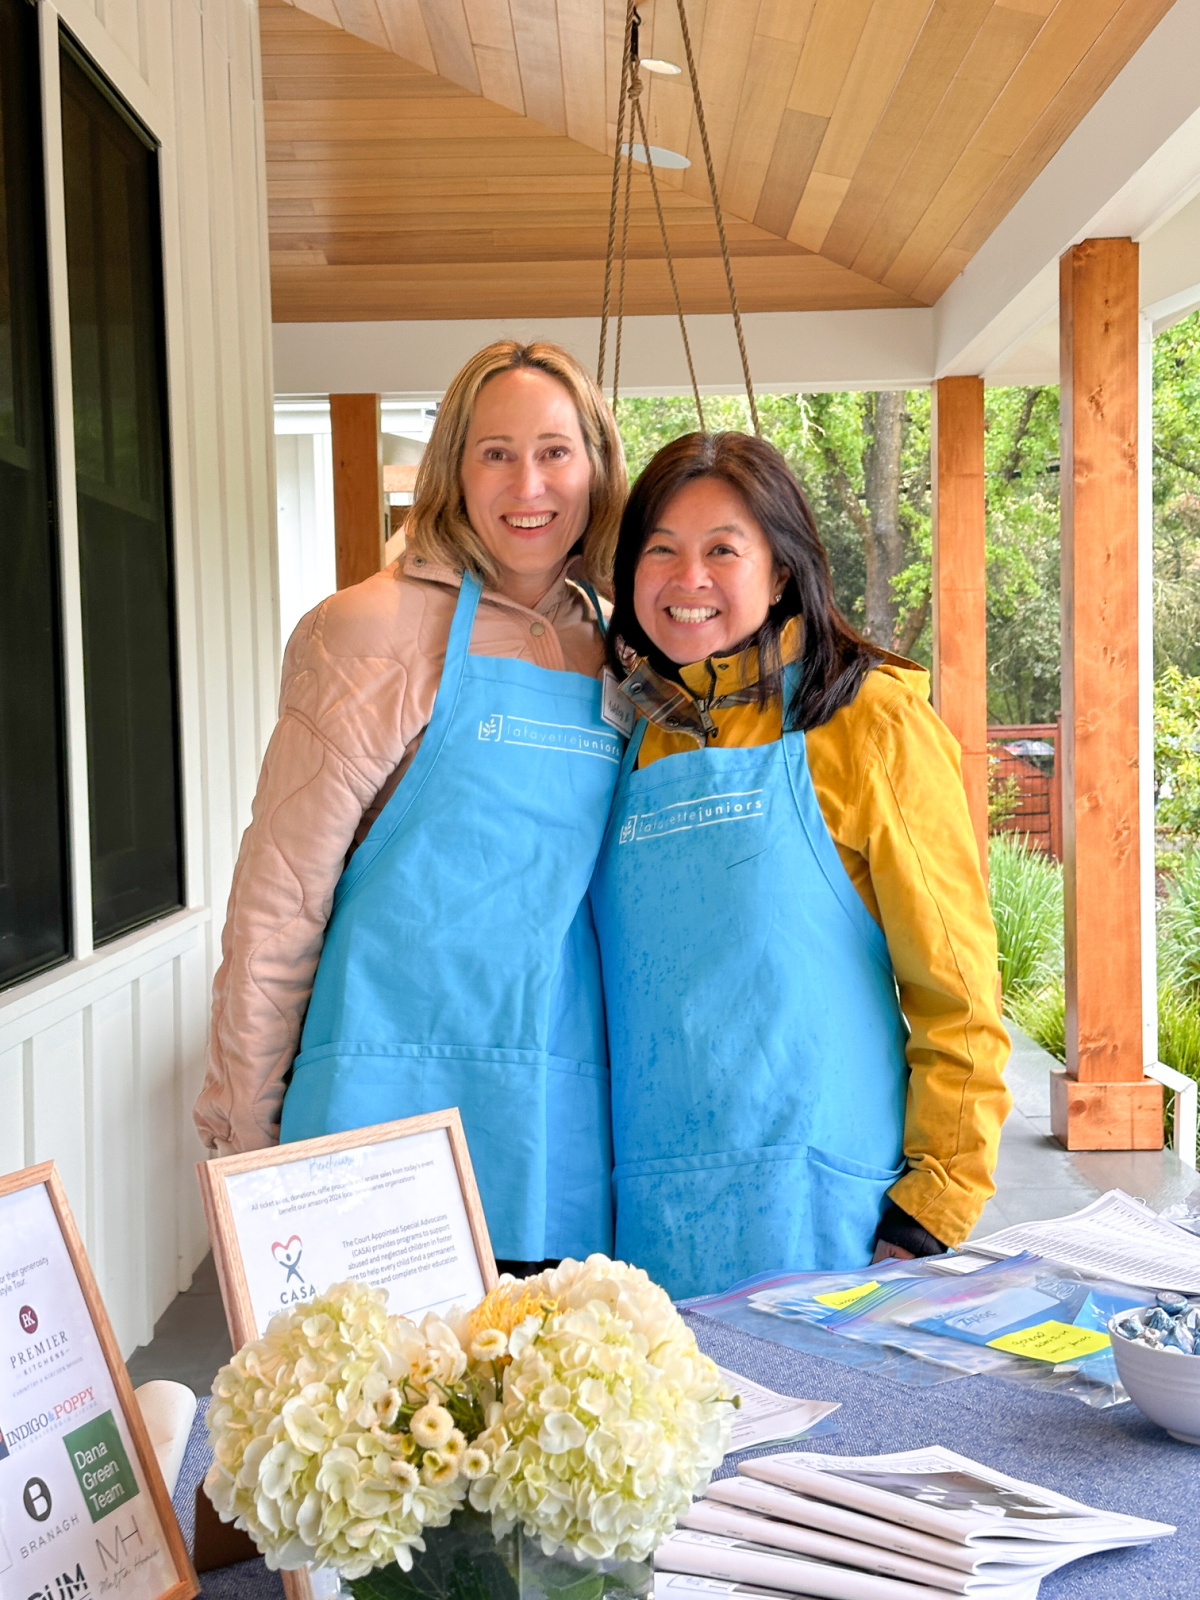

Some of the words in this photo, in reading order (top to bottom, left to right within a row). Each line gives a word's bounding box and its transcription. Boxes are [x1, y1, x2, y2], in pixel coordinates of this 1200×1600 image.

[639, 800, 762, 832] lafaettejuniors
[260, 1200, 274, 1209] ticket
[380, 1170, 392, 1178] sales
[278, 1204, 297, 1215] benefit
[307, 1198, 329, 1208] amazing
[329, 1194, 341, 1202] 2024
[342, 1240, 354, 1248] The
[354, 1234, 371, 1245] Court
[371, 1227, 400, 1241] Appointed
[400, 1220, 419, 1233] Special
[420, 1214, 448, 1226] Advocates
[351, 1247, 372, 1258] (CASA)
[372, 1239, 396, 1253] provides
[396, 1231, 422, 1245] programs
[429, 1224, 450, 1236] support
[348, 1258, 369, 1270] abused
[369, 1255, 380, 1264] and
[380, 1247, 408, 1260] neglected
[408, 1241, 431, 1253] children
[436, 1234, 453, 1244] foster
[360, 1271, 366, 1279] to
[367, 1267, 380, 1277] help
[380, 1261, 396, 1273] every
[396, 1257, 410, 1268] child
[410, 1255, 422, 1263] find
[427, 1245, 456, 1259] permanent
[380, 1275, 392, 1284] and
[391, 1268, 417, 1280] complete
[417, 1262, 431, 1273] their
[431, 1255, 458, 1268] education
[280, 1284, 316, 1305] CASA
[10, 1330, 69, 1369] PREMIER
[5, 1413, 49, 1447] INDIGO
[53, 1386, 95, 1420] POPPY
[74, 1441, 108, 1470] Dana
[82, 1460, 120, 1490] Green
[89, 1482, 126, 1512] Team
[20, 1513, 80, 1559] BRANAGH
